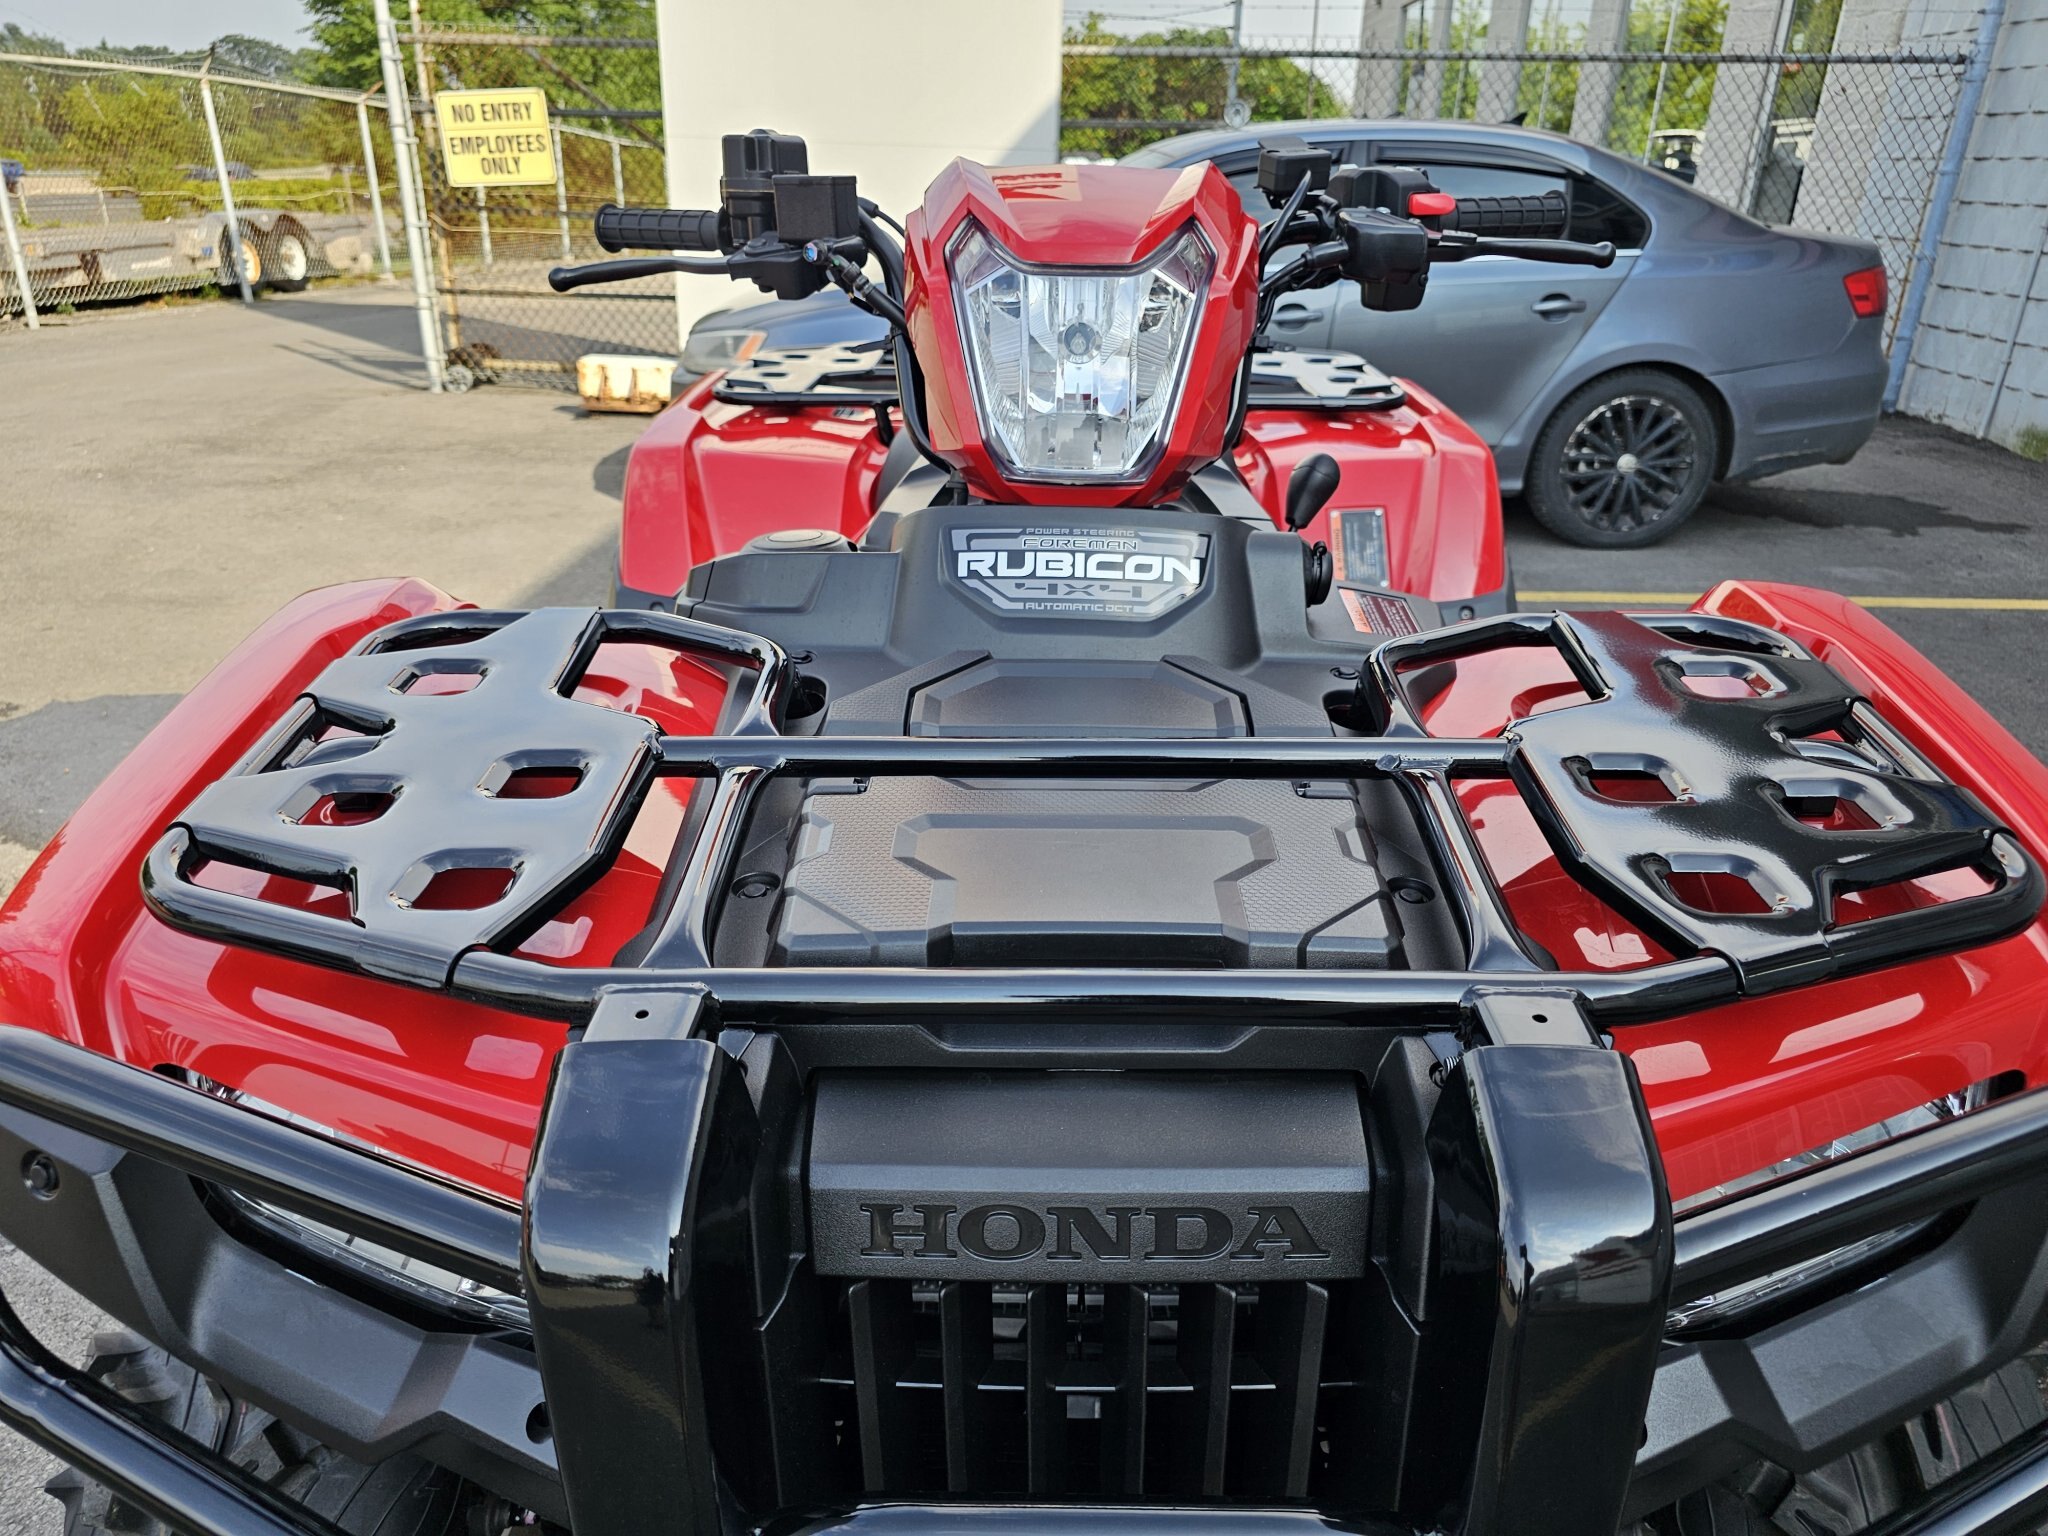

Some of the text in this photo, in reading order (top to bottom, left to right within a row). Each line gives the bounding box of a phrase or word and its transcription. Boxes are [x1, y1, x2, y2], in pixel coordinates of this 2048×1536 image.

[451, 102, 532, 123] NO ENTRY
[449, 134, 547, 155] EMPLOYEES
[481, 156, 521, 176] ONLY
[1026, 527, 1135, 537] POWER STEERING
[1022, 538, 1138, 551] FOREMAN
[957, 551, 1201, 584] RUBICON
[1025, 602, 1134, 613] AUTOMATIC DCT
[859, 1203, 1332, 1263] HONDA
